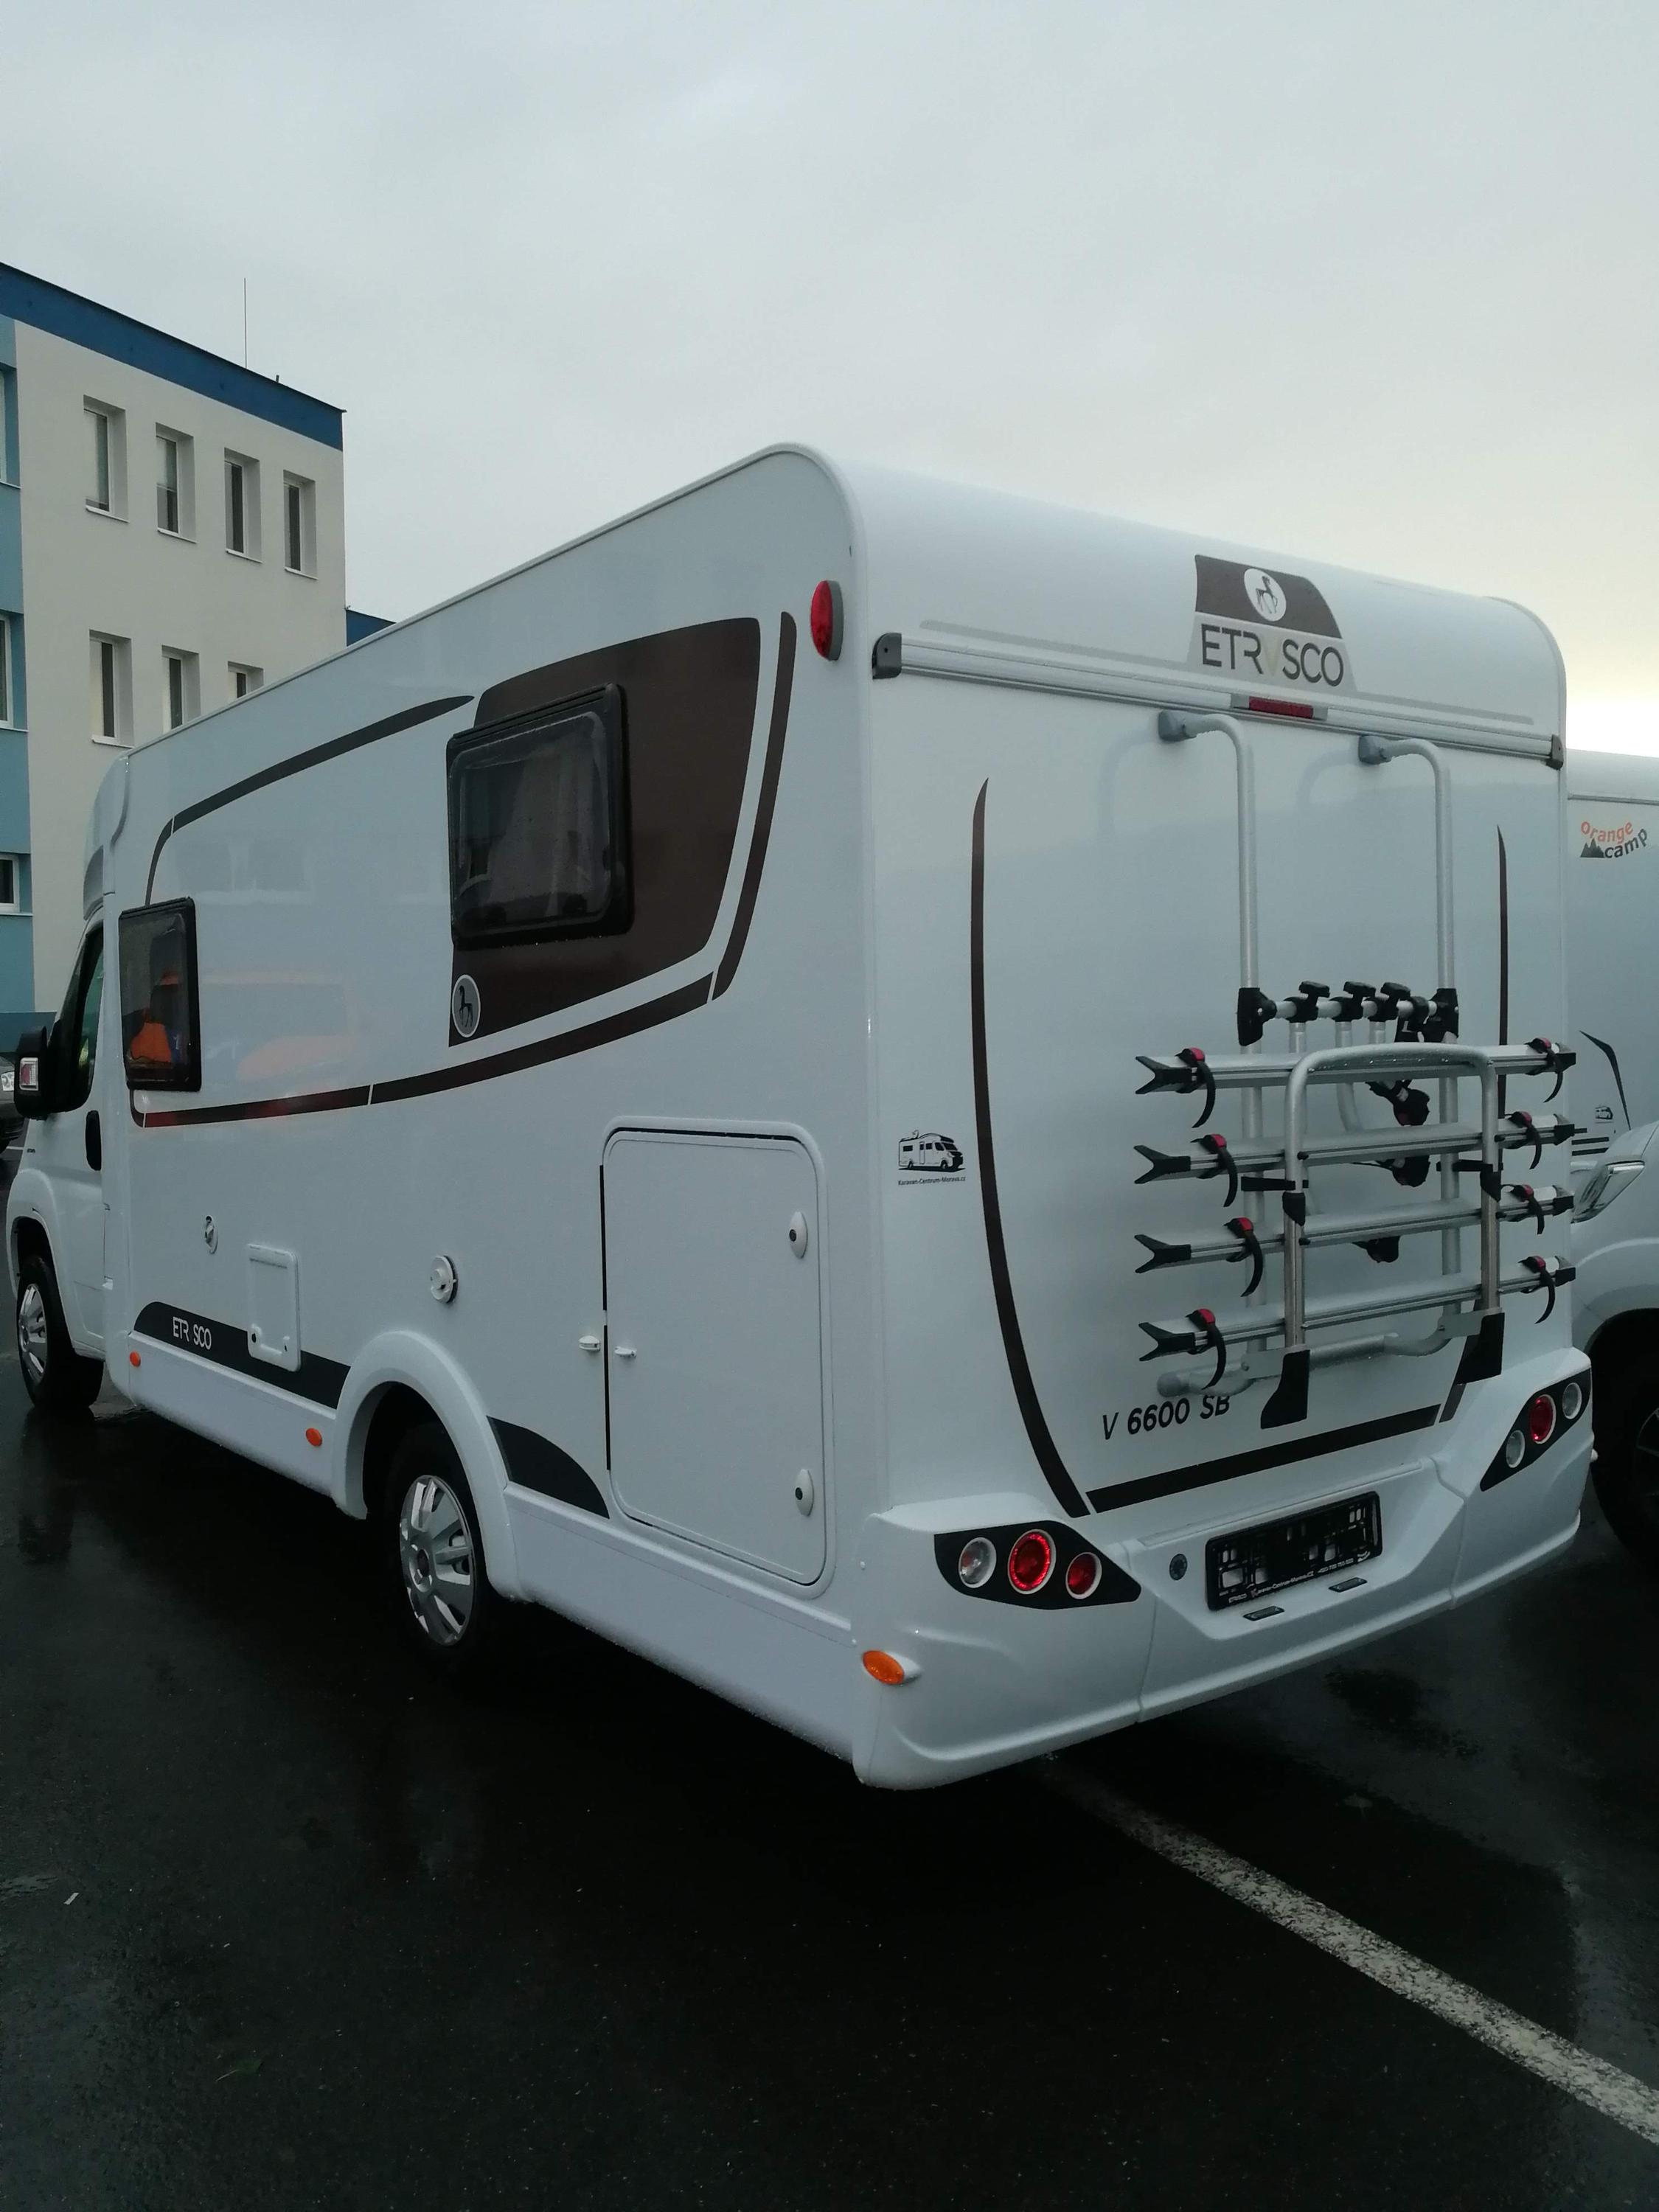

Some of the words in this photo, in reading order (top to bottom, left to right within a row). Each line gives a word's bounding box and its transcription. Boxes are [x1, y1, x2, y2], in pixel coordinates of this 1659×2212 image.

[1580, 821, 1634, 845] Orange
[1604, 828, 1647, 858] camp
[1102, 1411, 1119, 1440] V
[1127, 1397, 1191, 1435] 6600
[1199, 1394, 1231, 1419] SB
